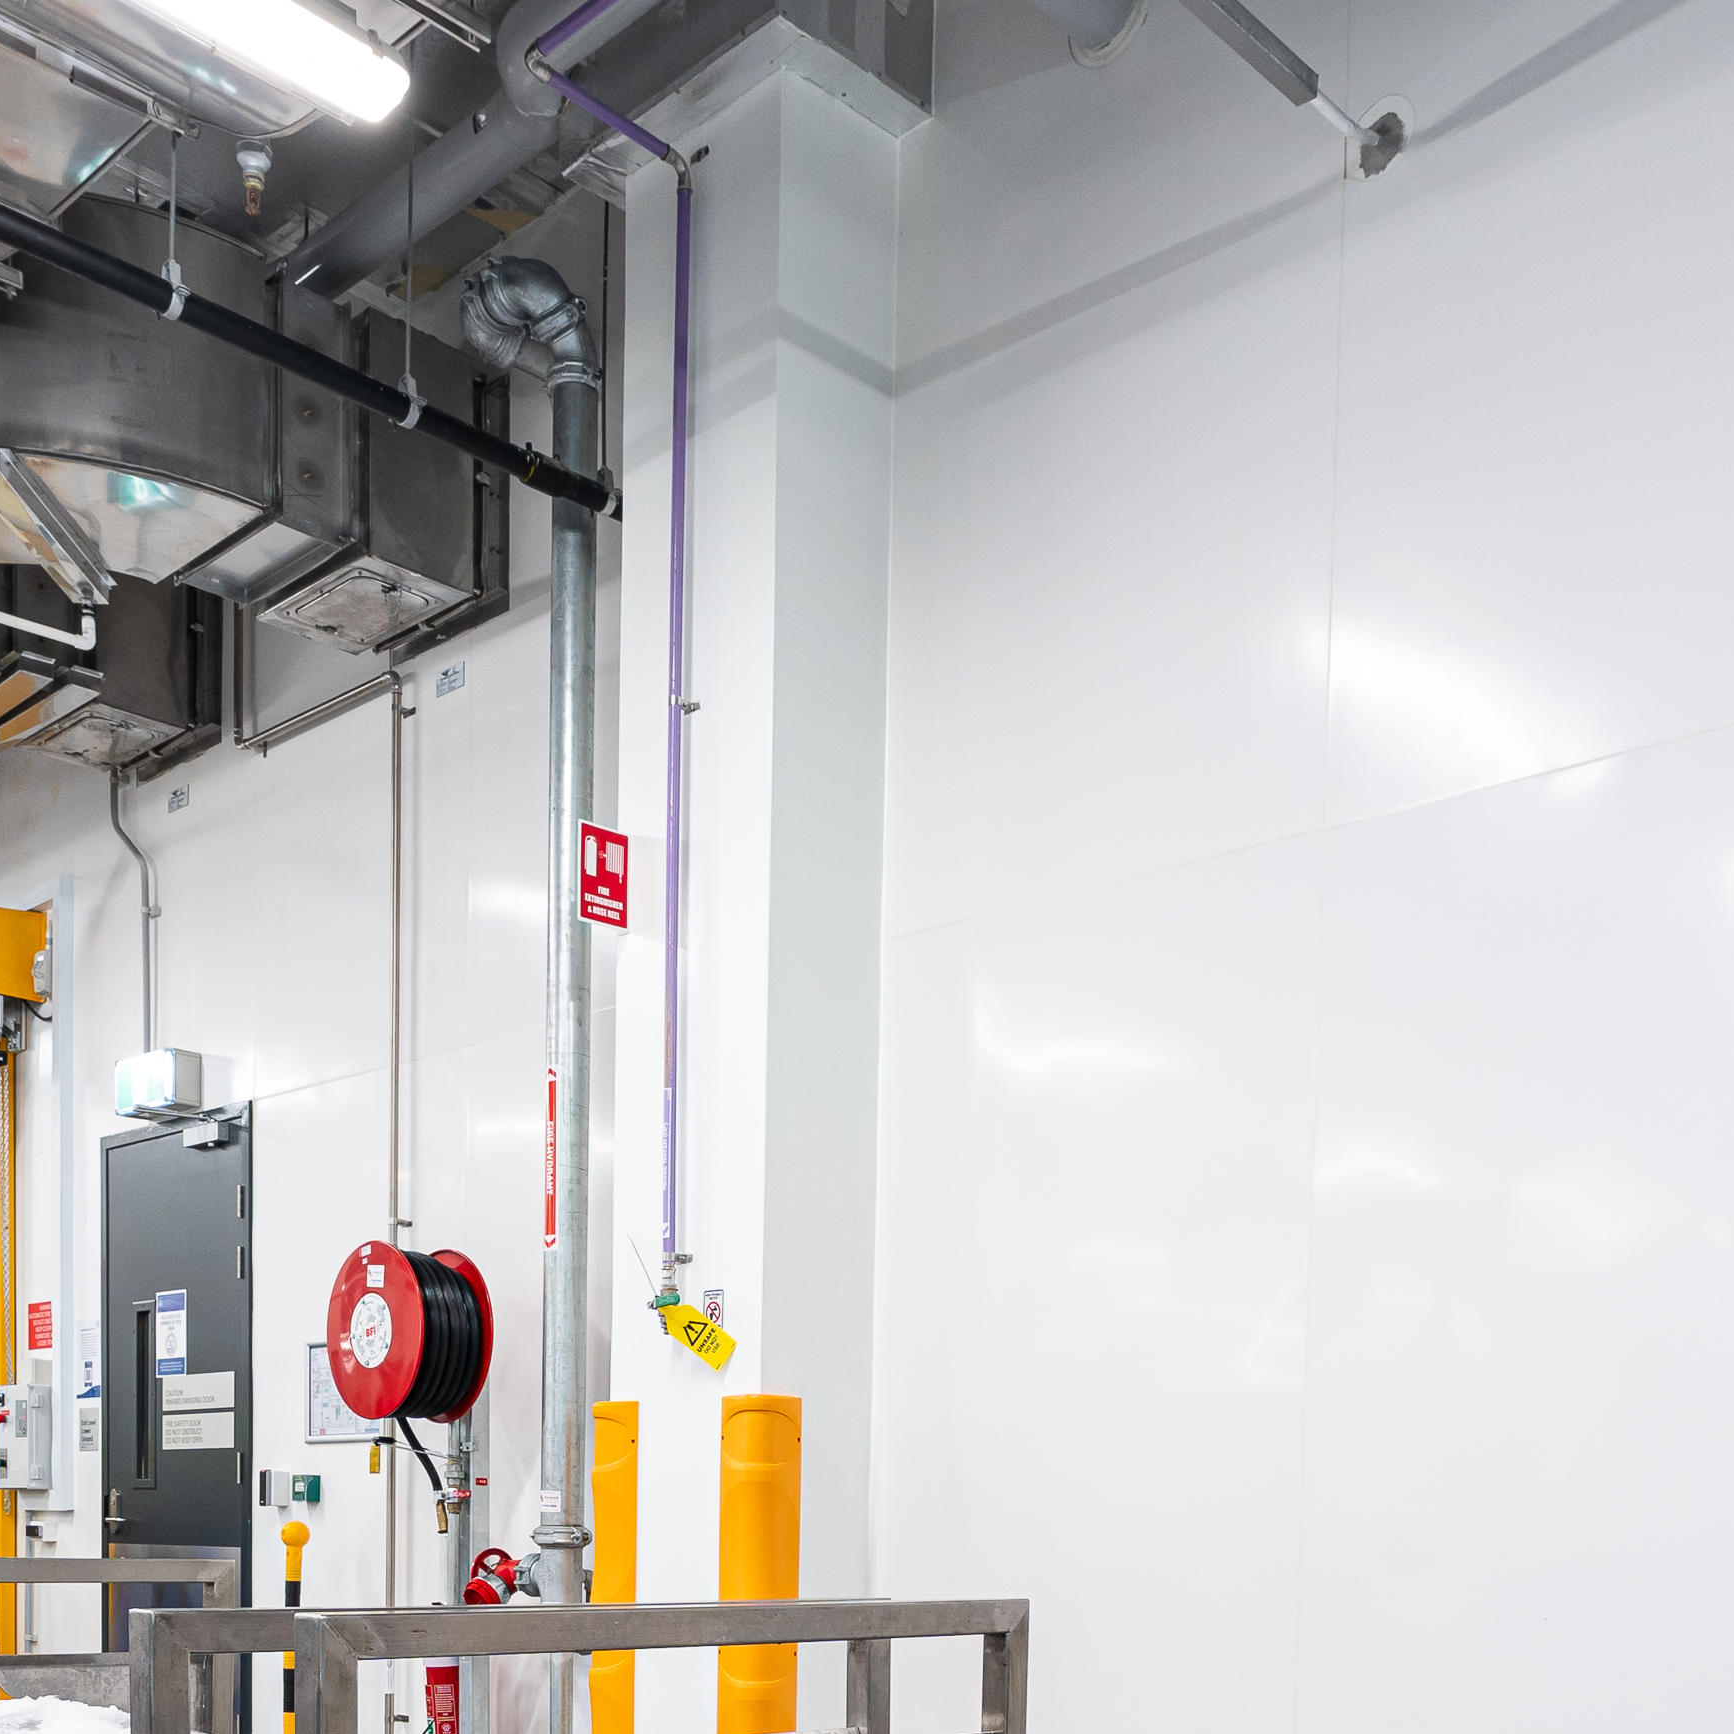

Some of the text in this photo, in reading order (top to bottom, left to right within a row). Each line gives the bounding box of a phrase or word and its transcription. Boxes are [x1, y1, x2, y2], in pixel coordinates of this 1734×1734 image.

[598, 886, 610, 896] FIRE
[585, 892, 623, 910] EXTINGUISHER
[593, 906, 607, 917] HOSE
[607, 910, 621, 920] REEL
[697, 1328, 716, 1352] UNSAFE
[704, 1335, 718, 1354] DO NOT
[711, 1344, 721, 1354] USE
